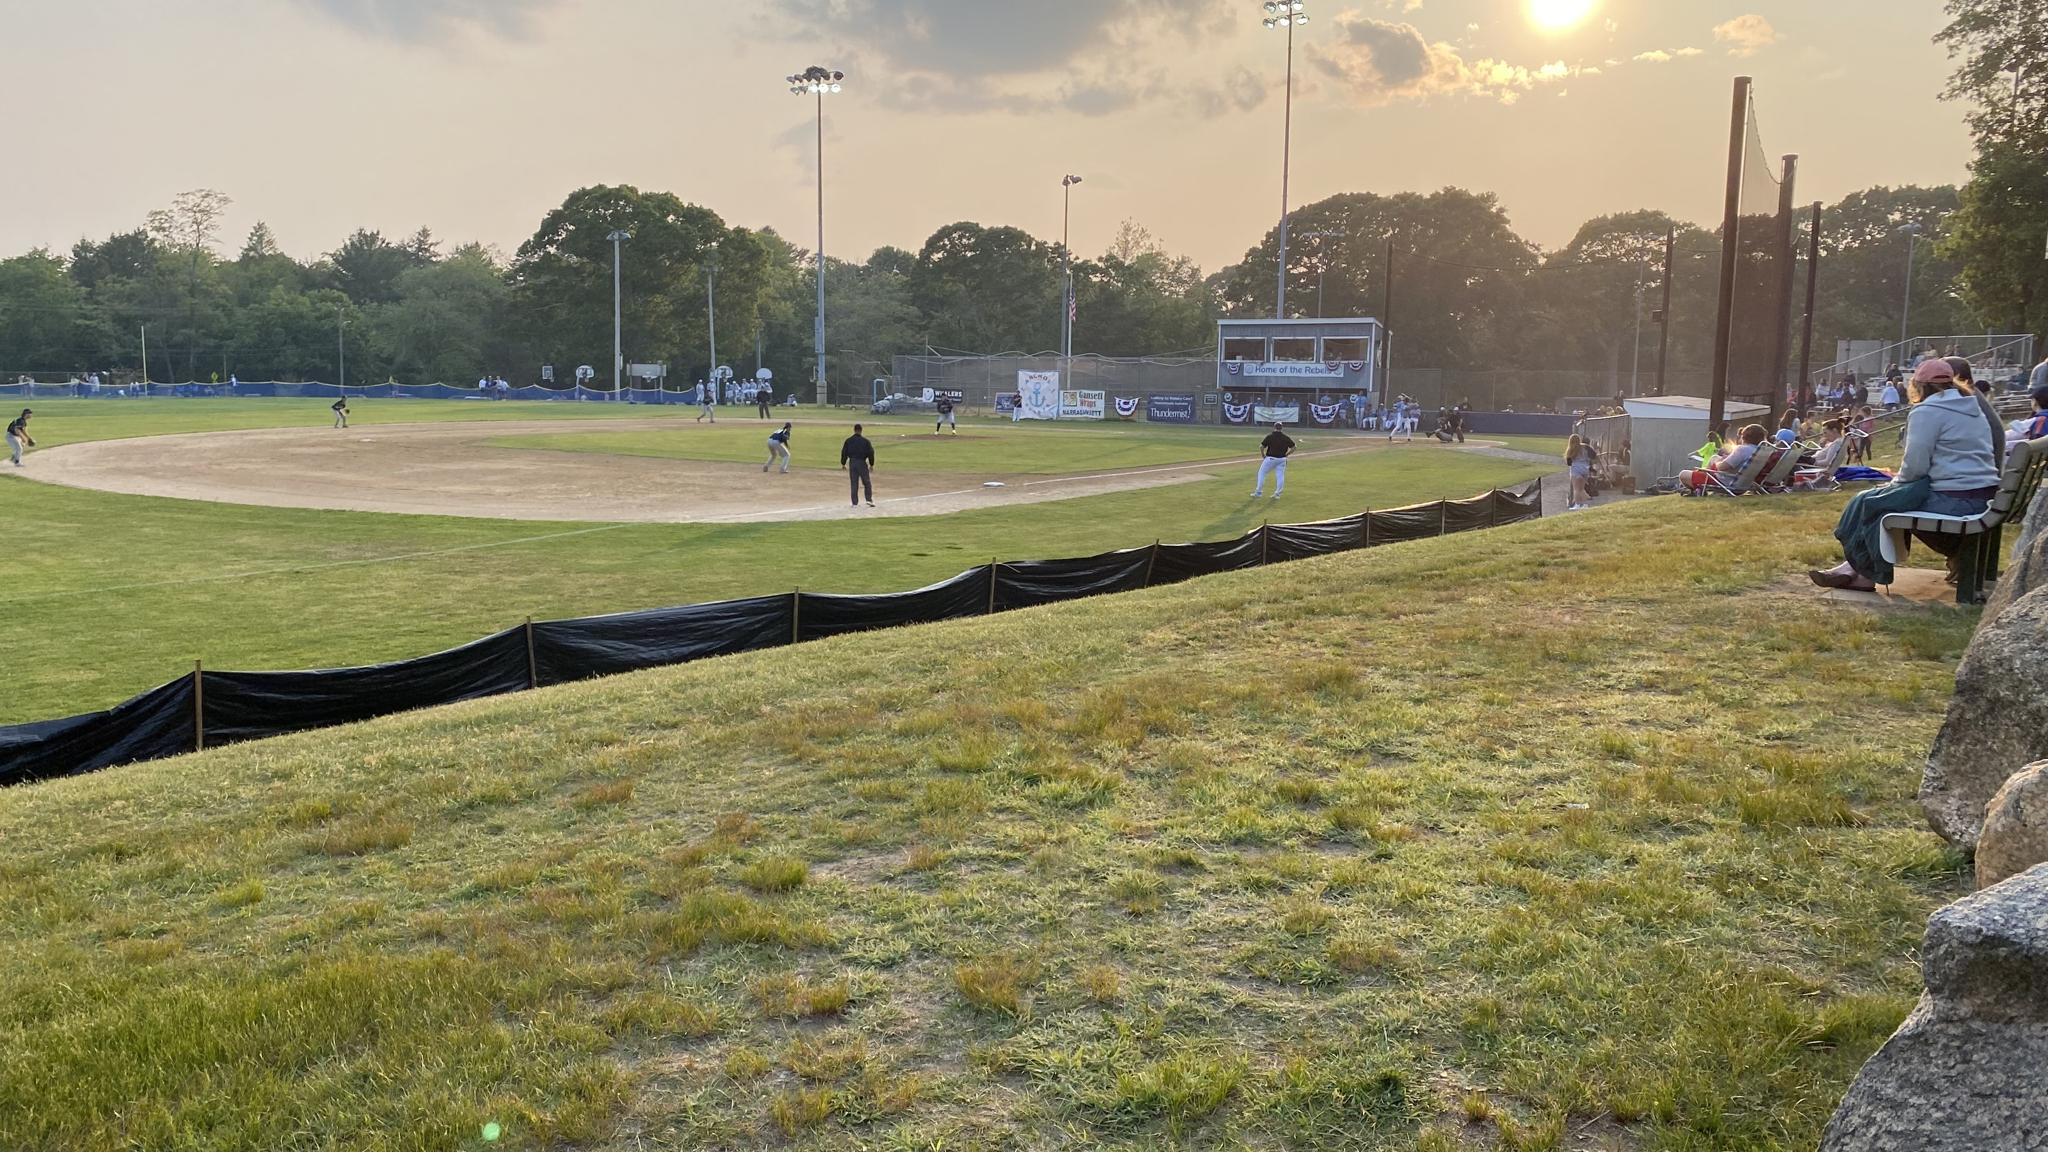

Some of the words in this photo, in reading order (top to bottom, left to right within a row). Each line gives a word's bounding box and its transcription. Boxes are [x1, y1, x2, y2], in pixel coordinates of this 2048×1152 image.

[1255, 365, 1277, 373] Home
[1280, 365, 1287, 373] of
[1290, 365, 1303, 374] the
[1079, 391, 1103, 400] Gansett
